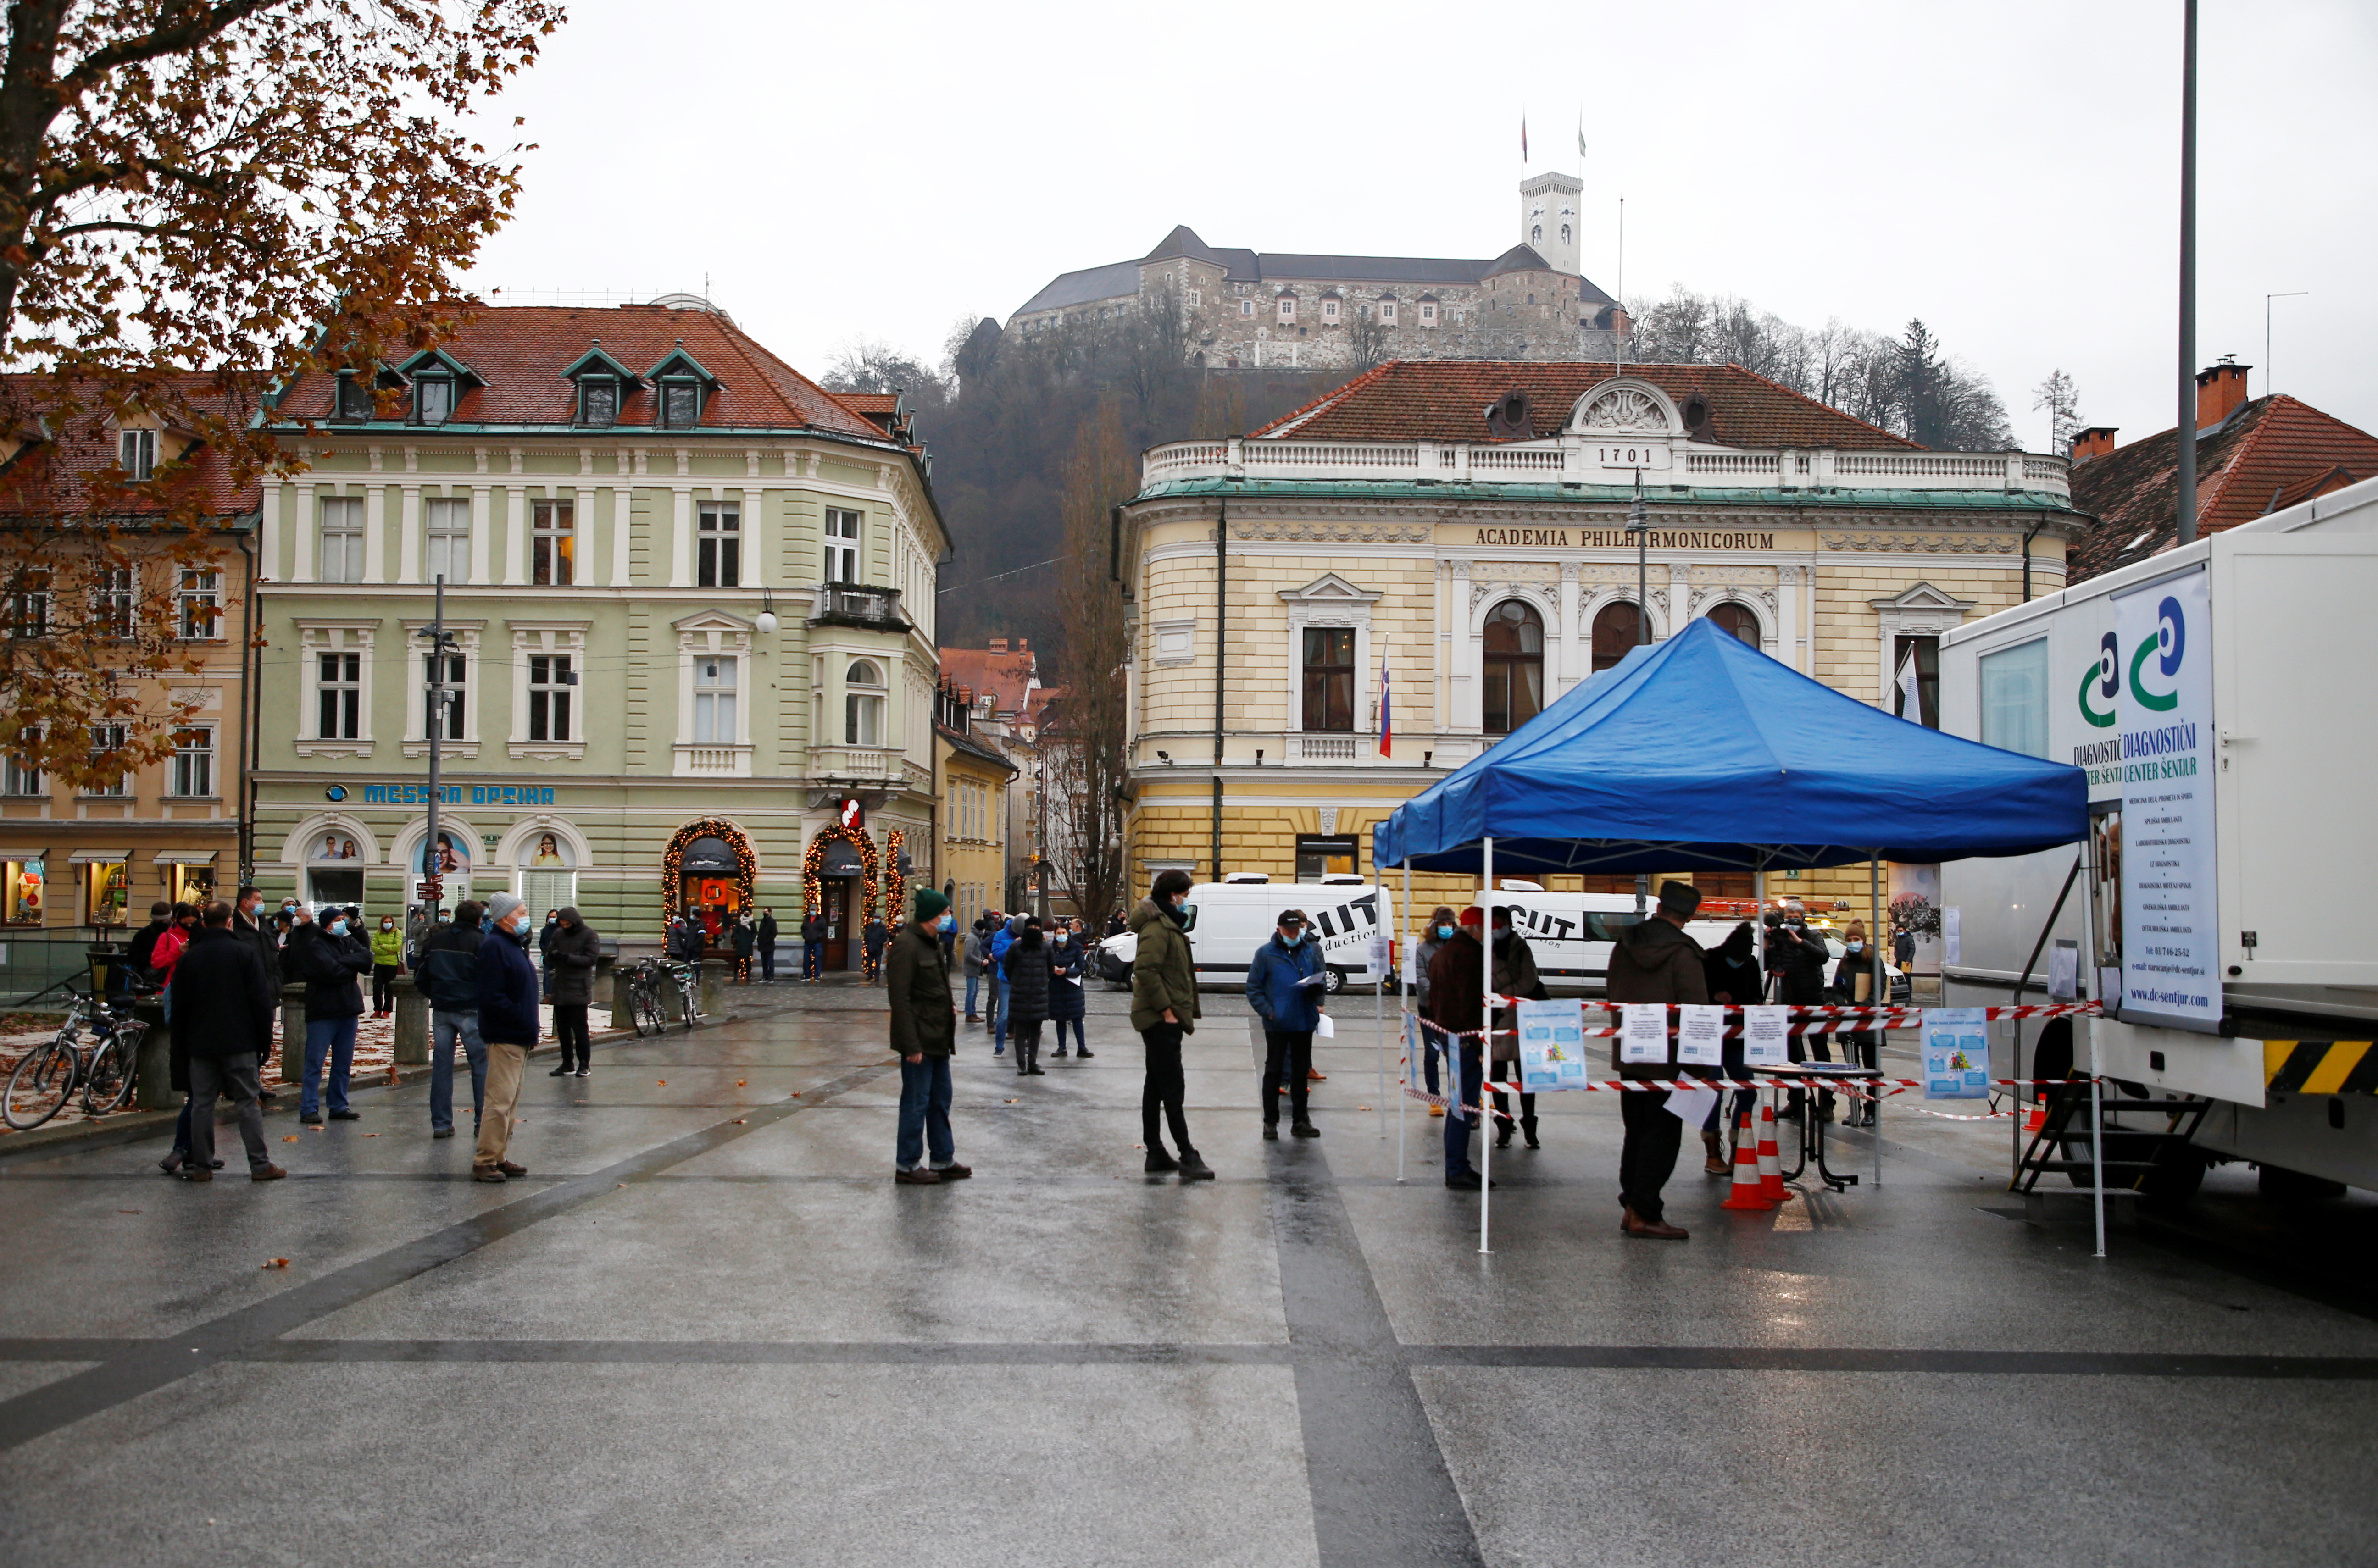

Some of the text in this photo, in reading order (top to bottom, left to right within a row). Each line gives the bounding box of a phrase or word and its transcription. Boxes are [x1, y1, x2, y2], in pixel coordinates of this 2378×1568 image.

[1599, 448, 1650, 462] 1701
[1475, 529, 1568, 546] ACADEMIA
[2124, 718, 2195, 759] DIAGNOSTIČNI
[2074, 733, 2121, 766] DIAGNOSTIČ
[2125, 757, 2196, 783] CENTER ŠENTJUR
[473, 787, 555, 804] OPTIKA
[2129, 796, 2147, 804] MEDICINA
[2131, 988, 2208, 1007] www.dc-sentjur.com
